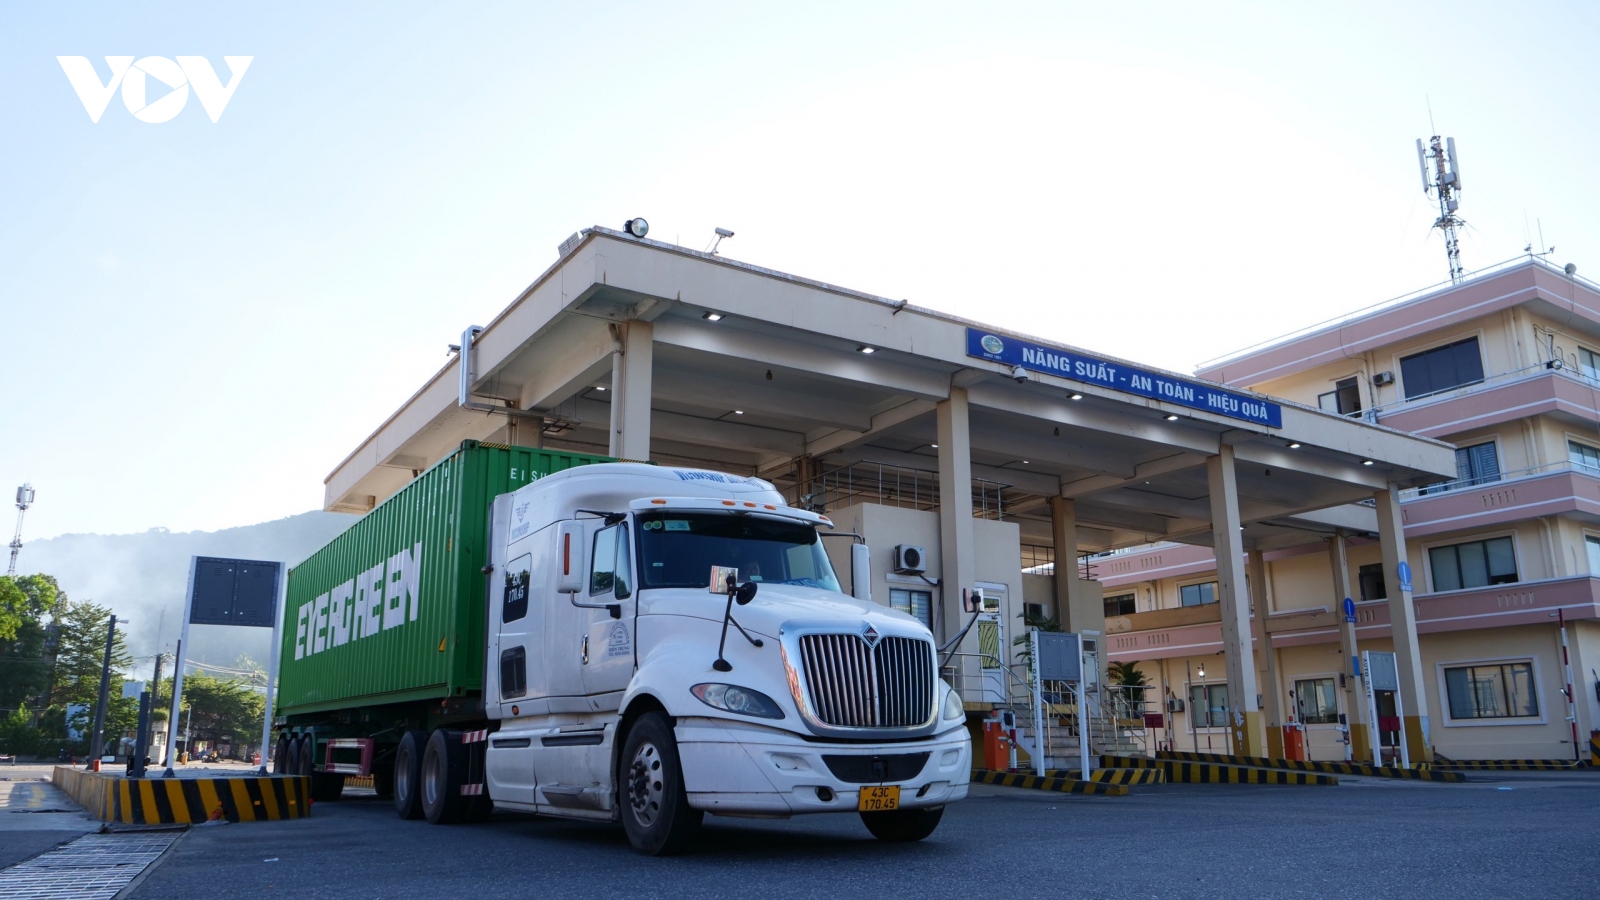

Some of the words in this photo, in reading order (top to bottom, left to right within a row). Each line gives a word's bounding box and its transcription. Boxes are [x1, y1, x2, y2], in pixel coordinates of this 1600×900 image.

[1022, 347, 1070, 372] NĂNG
[1075, 362, 1116, 382] SUẤT
[1131, 374, 1152, 391] AN
[1156, 380, 1194, 401] TOÀN
[1208, 393, 1238, 412] HIỆU
[1242, 402, 1268, 419] QUẢ
[295, 541, 422, 660] EVERGREEN
[865, 798, 895, 810] 170.45
[872, 787, 889, 798] 43C
